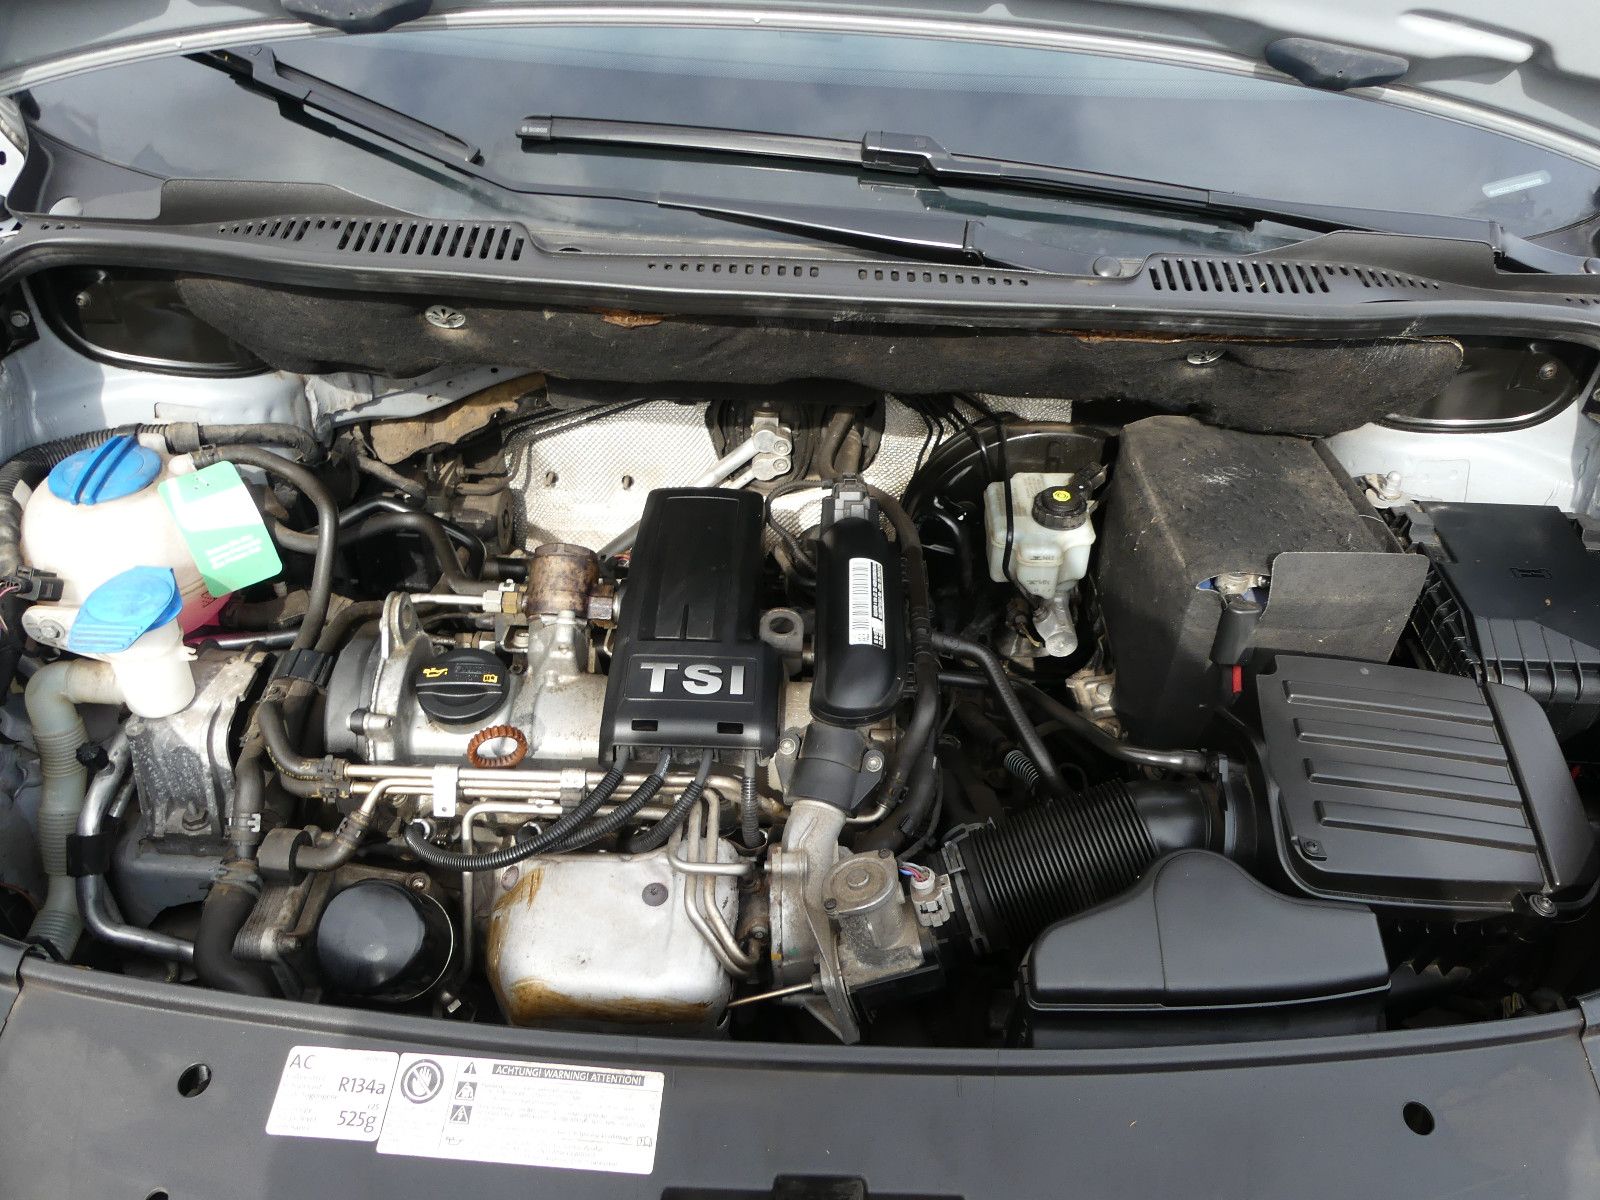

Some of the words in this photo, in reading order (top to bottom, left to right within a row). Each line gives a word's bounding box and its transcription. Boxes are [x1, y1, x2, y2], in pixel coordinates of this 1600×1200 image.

[640, 662, 745, 695] TSI
[289, 1053, 316, 1070] AC
[338, 1076, 386, 1095] R134a
[495, 1064, 542, 1077] ACHTUNG!
[543, 1068, 589, 1082] WARNING!
[590, 1073, 642, 1086] ATTENTION!
[337, 1110, 377, 1133] 525g
